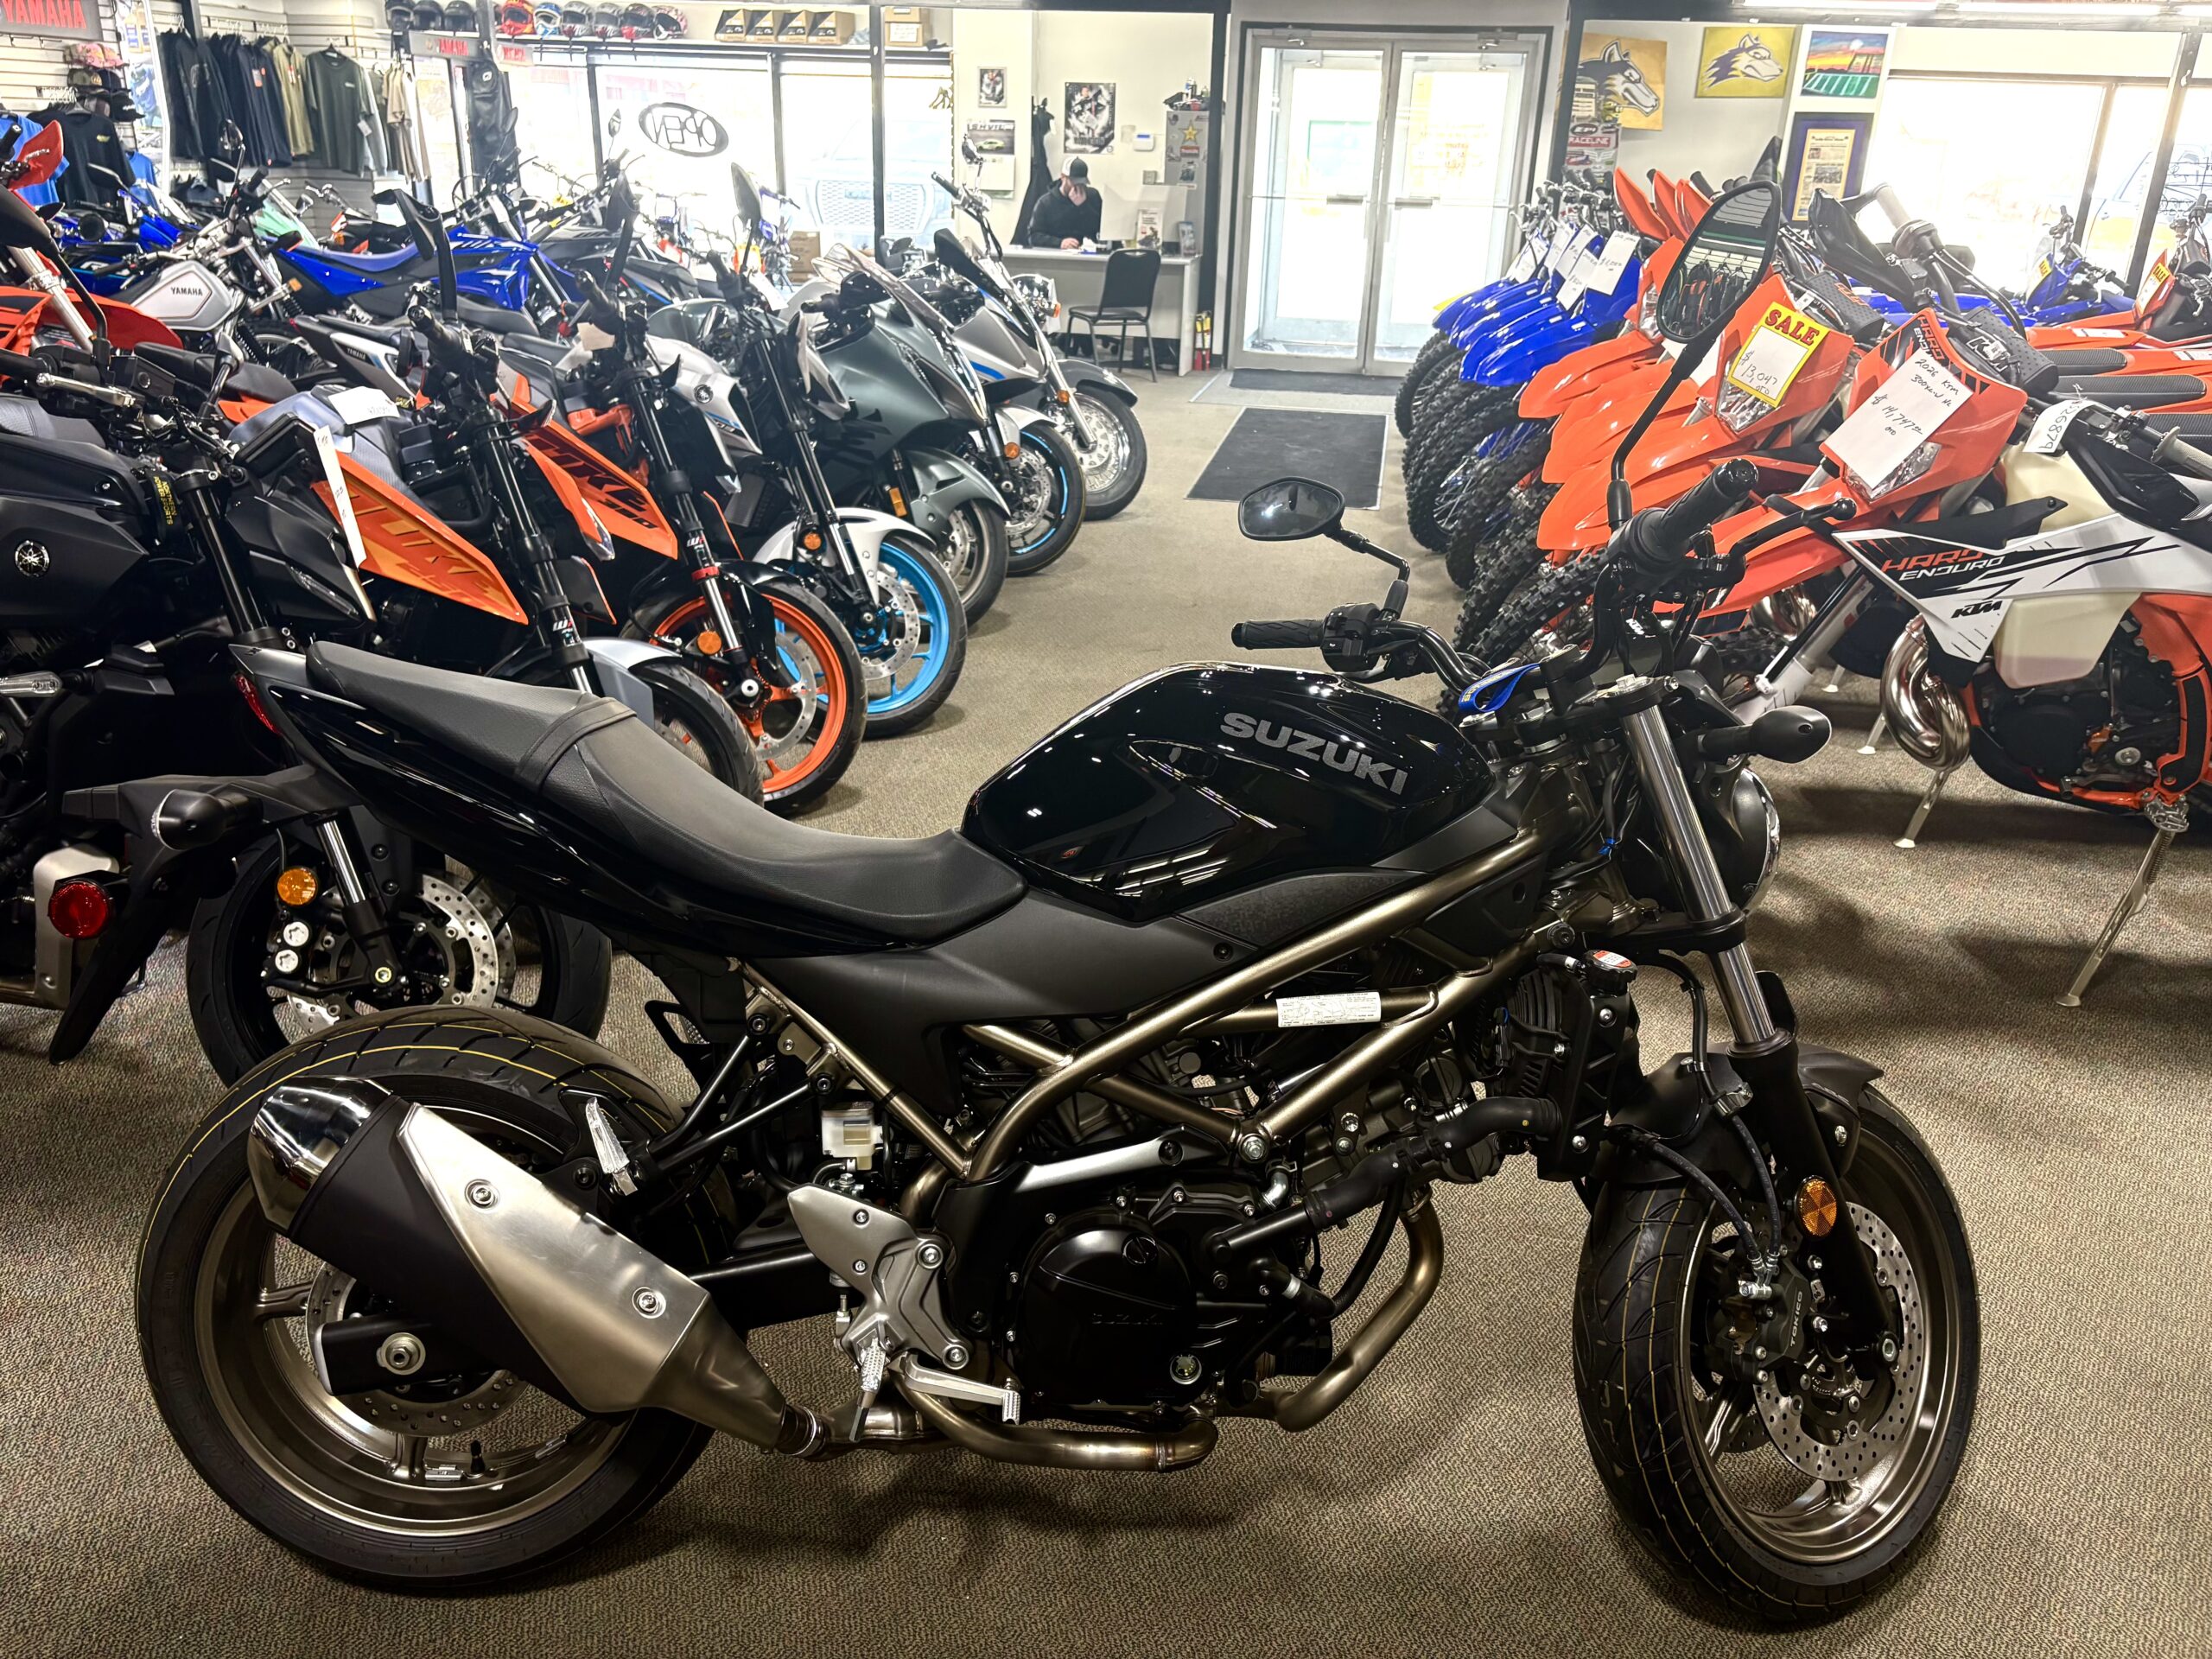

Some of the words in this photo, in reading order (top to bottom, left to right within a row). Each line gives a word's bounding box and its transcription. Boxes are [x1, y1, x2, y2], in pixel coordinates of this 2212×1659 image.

[2, 0, 86, 29] YAMAHA
[170, 286, 203, 296] YAMAHA
[1764, 308, 1820, 346] SALE
[1738, 350, 1755, 365] $
[1967, 336, 2011, 372] KM
[1915, 359, 1939, 378] 2026
[1941, 379, 1960, 396] KTM
[1871, 393, 1887, 406] $
[1880, 548, 1985, 572] HARD
[1899, 556, 2005, 582] ENDURO
[1951, 600, 2003, 619] KTM
[1220, 712, 1408, 795] SUZUKI
[1790, 1291, 1802, 1347] TOKICO
